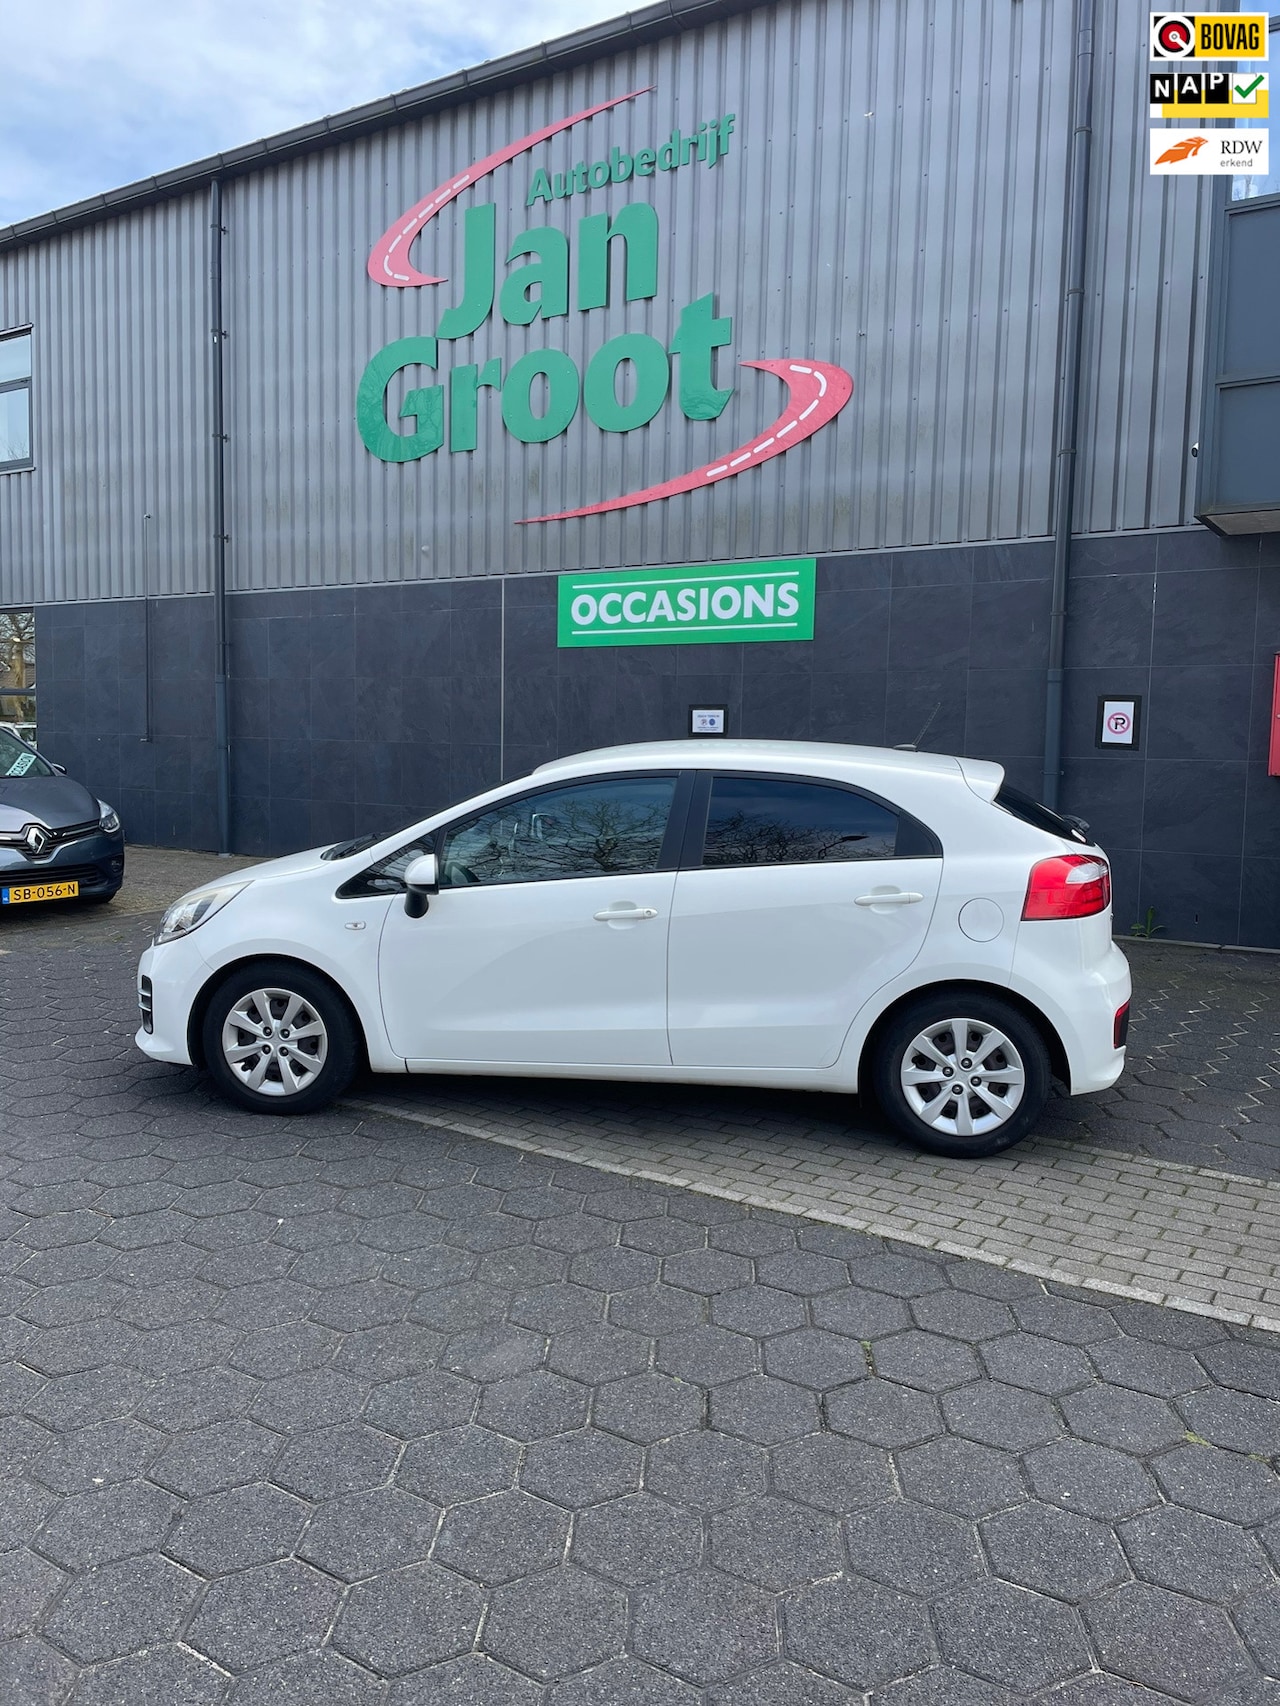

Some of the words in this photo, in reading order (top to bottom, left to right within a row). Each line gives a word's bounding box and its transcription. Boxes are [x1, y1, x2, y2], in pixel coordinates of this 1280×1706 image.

[525, 113, 736, 207] Autobedrijf
[437, 201, 659, 340] Jan
[356, 291, 736, 463] Groot
[571, 582, 800, 626] OCCASIONS
[13, 883, 76, 901] SB-056-N
